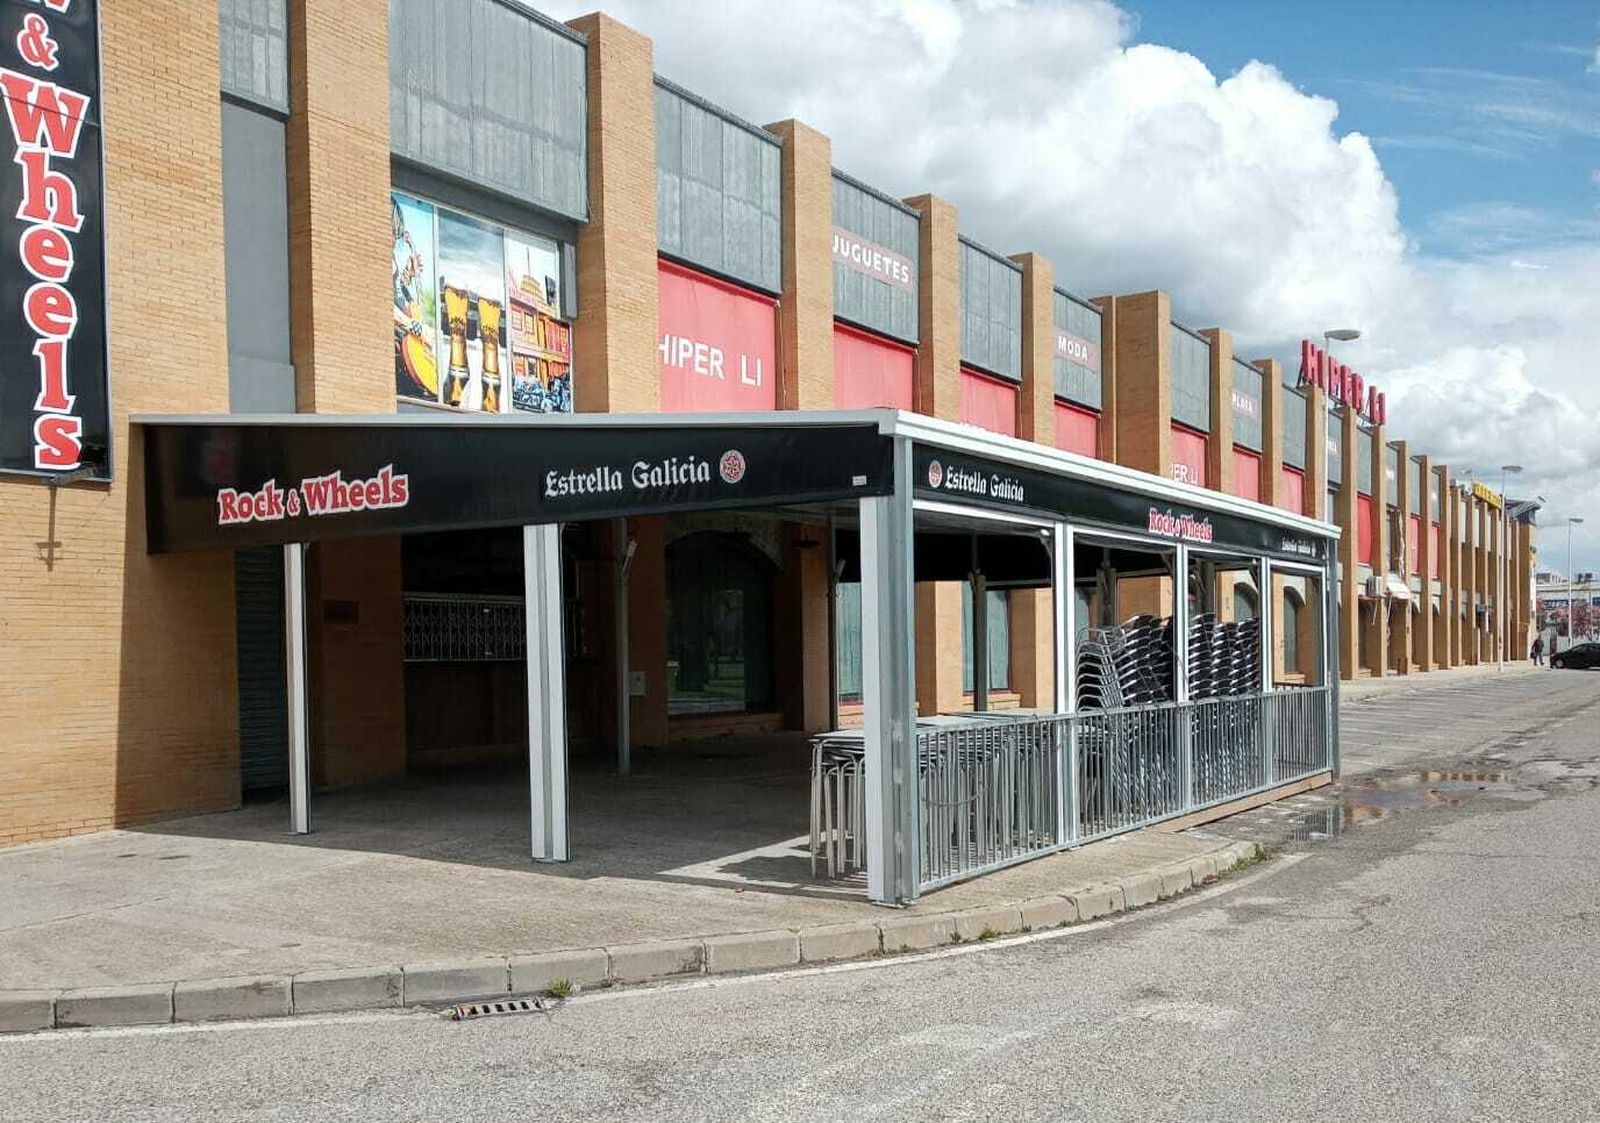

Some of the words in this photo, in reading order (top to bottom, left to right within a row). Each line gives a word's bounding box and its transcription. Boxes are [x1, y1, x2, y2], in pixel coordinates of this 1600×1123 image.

[17, 12, 59, 71] &
[0, 66, 91, 470] Wheels
[832, 232, 909, 283] JUGUETES
[659, 333, 725, 380] HIPER
[1058, 335, 1088, 361] MODA
[218, 479, 284, 525] Rock
[287, 488, 301, 517] &
[301, 464, 409, 516] Wheels
[545, 466, 623, 498] Estrella
[631, 455, 711, 490] Galicia
[945, 465, 987, 495] Estrella
[990, 474, 1025, 502] Galicia
[1149, 506, 1175, 537] Rock
[1180, 514, 1213, 544] Wheels
